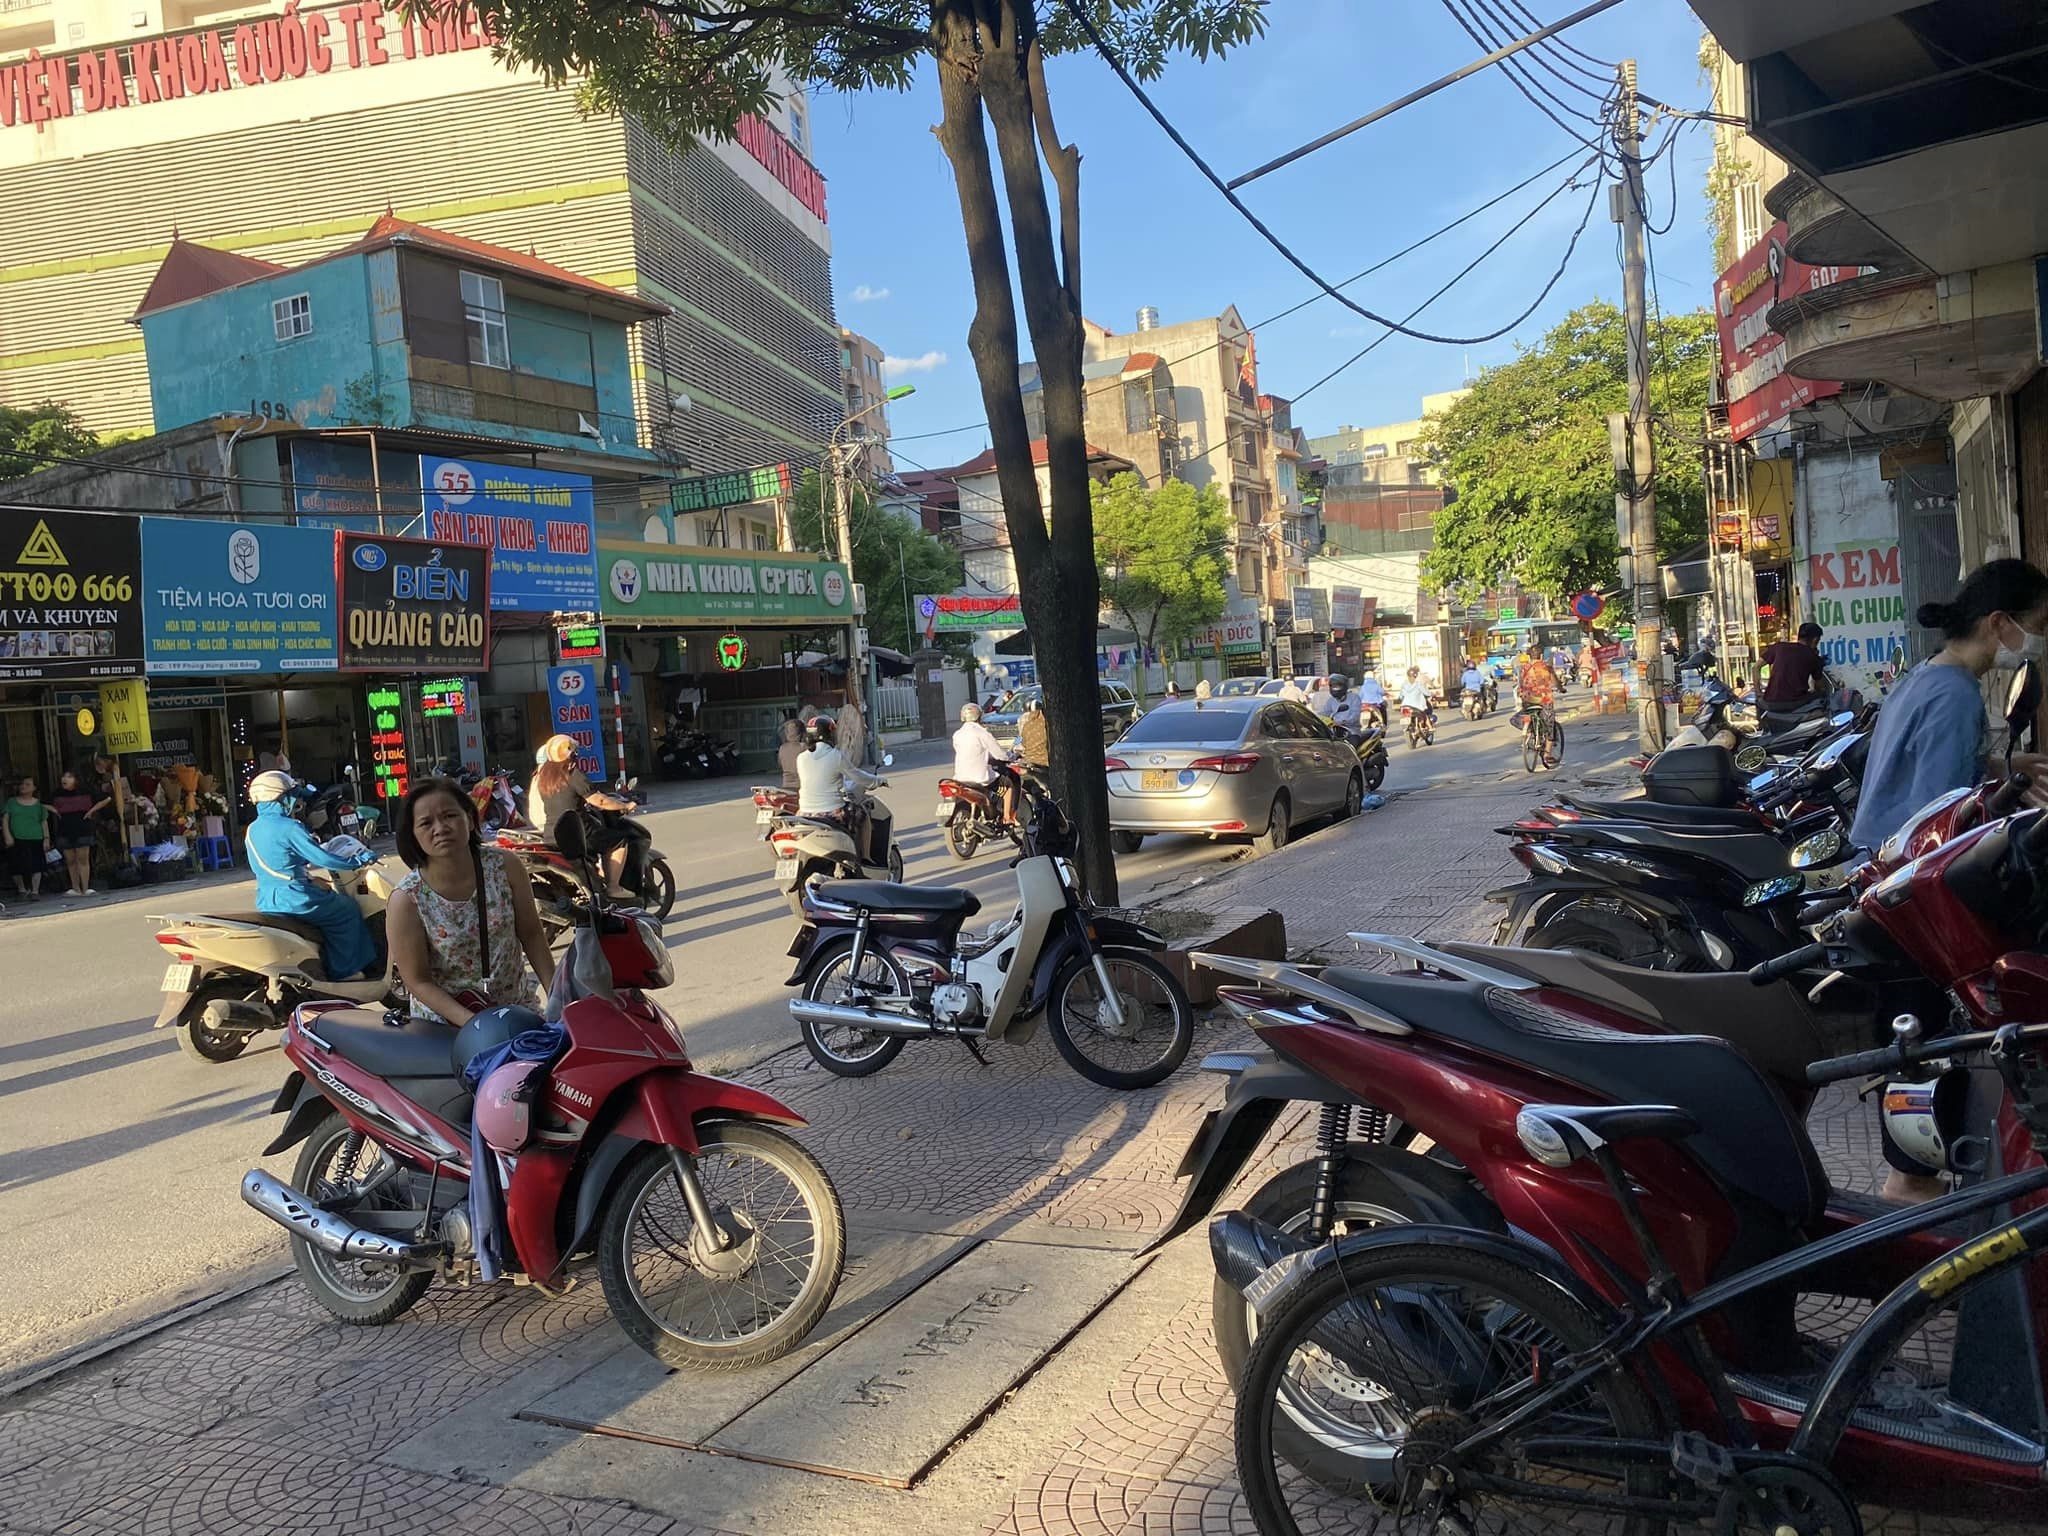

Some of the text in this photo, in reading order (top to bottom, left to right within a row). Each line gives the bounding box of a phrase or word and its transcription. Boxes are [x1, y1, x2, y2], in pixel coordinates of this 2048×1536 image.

[0, 50, 73, 133] VIỆN
[78, 49, 129, 112] ĐA
[133, 30, 230, 104] KHOA
[234, 0, 332, 86] QUỐC
[441, 472, 470, 494] 55
[432, 500, 464, 544] SẢN
[499, 516, 537, 552] KHOA
[393, 547, 469, 601] BIỂN
[646, 562, 697, 592] NHA
[699, 565, 757, 593] KHOA
[1810, 546, 1901, 591] KEM
[83, 575, 133, 602] 666
[157, 586, 326, 610] TIỆM HOA TƯƠI ORI
[13, 607, 40, 623] VÀ
[349, 599, 484, 649] QUẢNG CÁO
[1850, 595, 1905, 625] CHUA
[1194, 623, 1253, 644] HIÊN ĐỨC
[561, 676, 581, 690] 55
[559, 697, 592, 722] SẢN
[554, 1080, 593, 1108] YAMAHA
